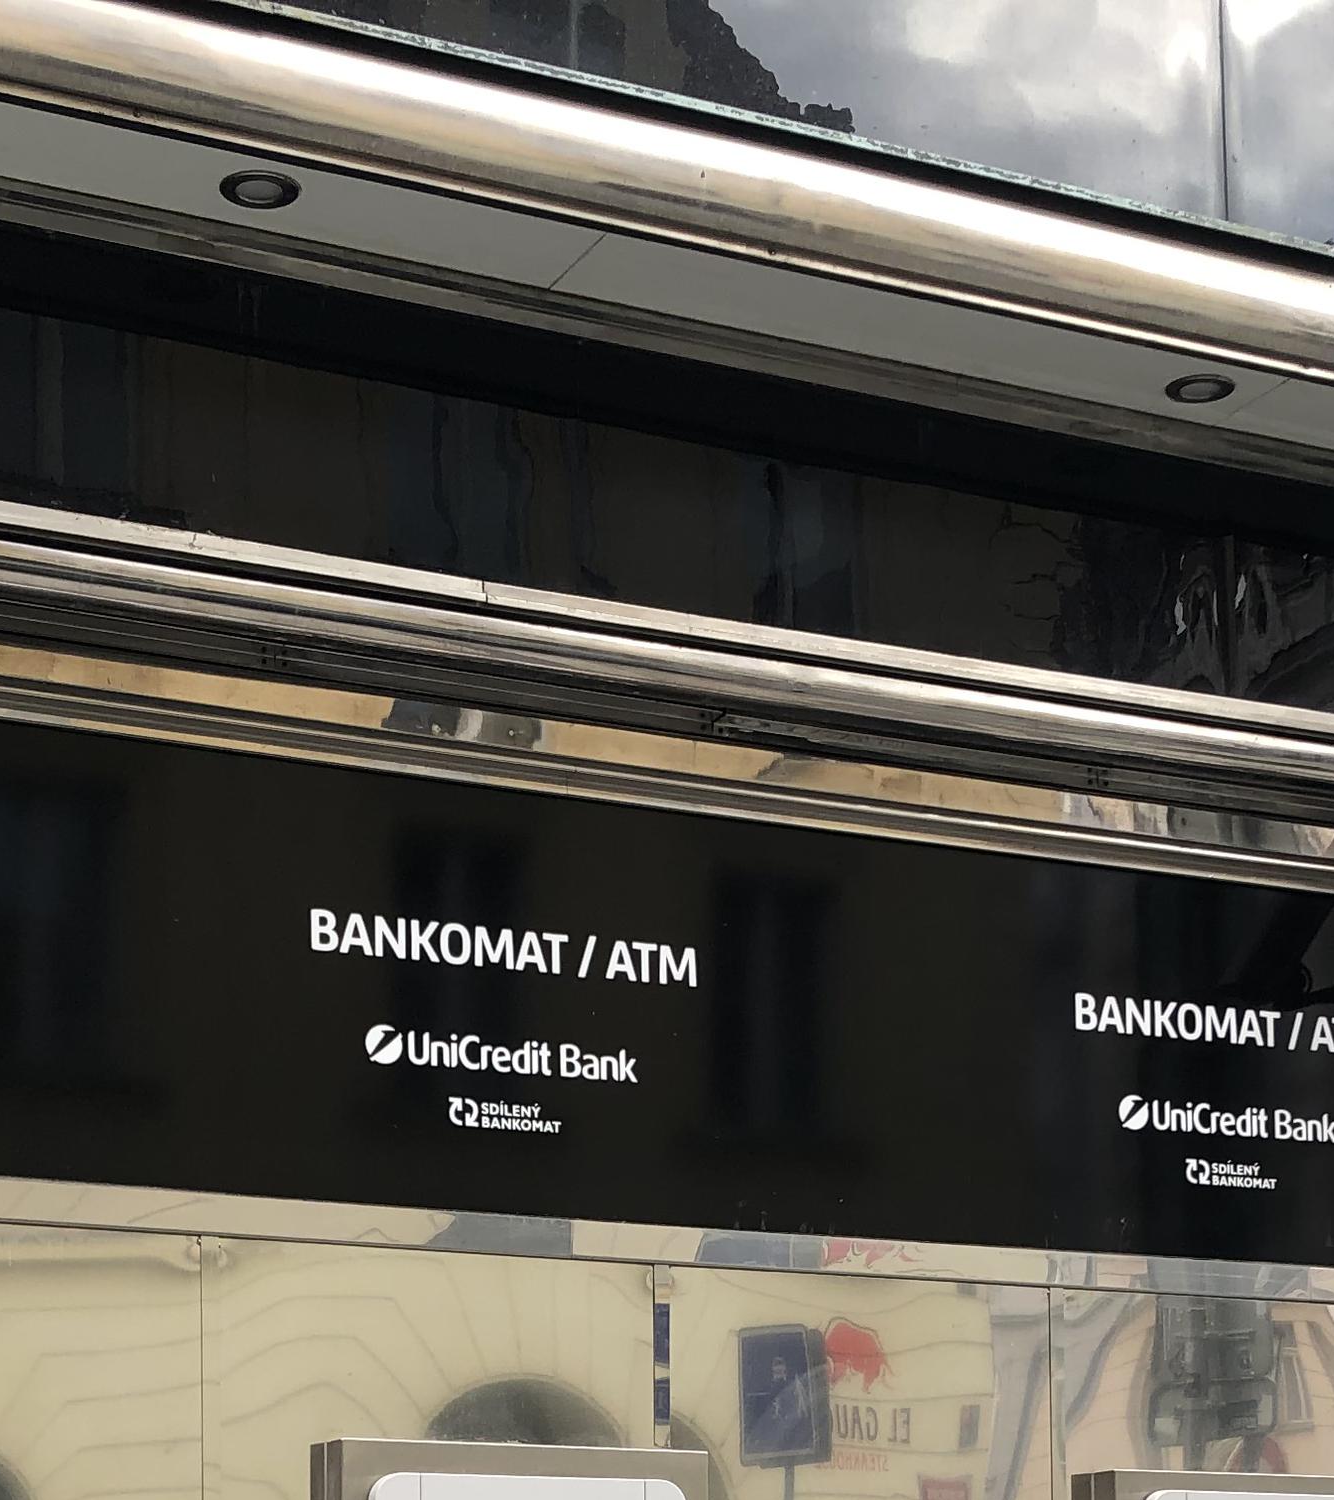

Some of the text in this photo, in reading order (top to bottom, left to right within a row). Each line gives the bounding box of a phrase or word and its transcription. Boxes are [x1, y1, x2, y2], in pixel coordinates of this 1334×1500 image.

[309, 908, 569, 975] BANKOMAT
[605, 940, 698, 988] ATM
[1074, 992, 1281, 1048] BANKOMAT
[407, 1030, 639, 1084] UniCredit Bank
[481, 1100, 541, 1118] SDÍLENÝ
[1152, 1100, 1269, 1138] UniCredit
[481, 1116, 562, 1134] BANKOMAT
[1211, 1160, 1260, 1176] SDÍLENÝ
[1211, 1174, 1277, 1190] BANKOMAT
